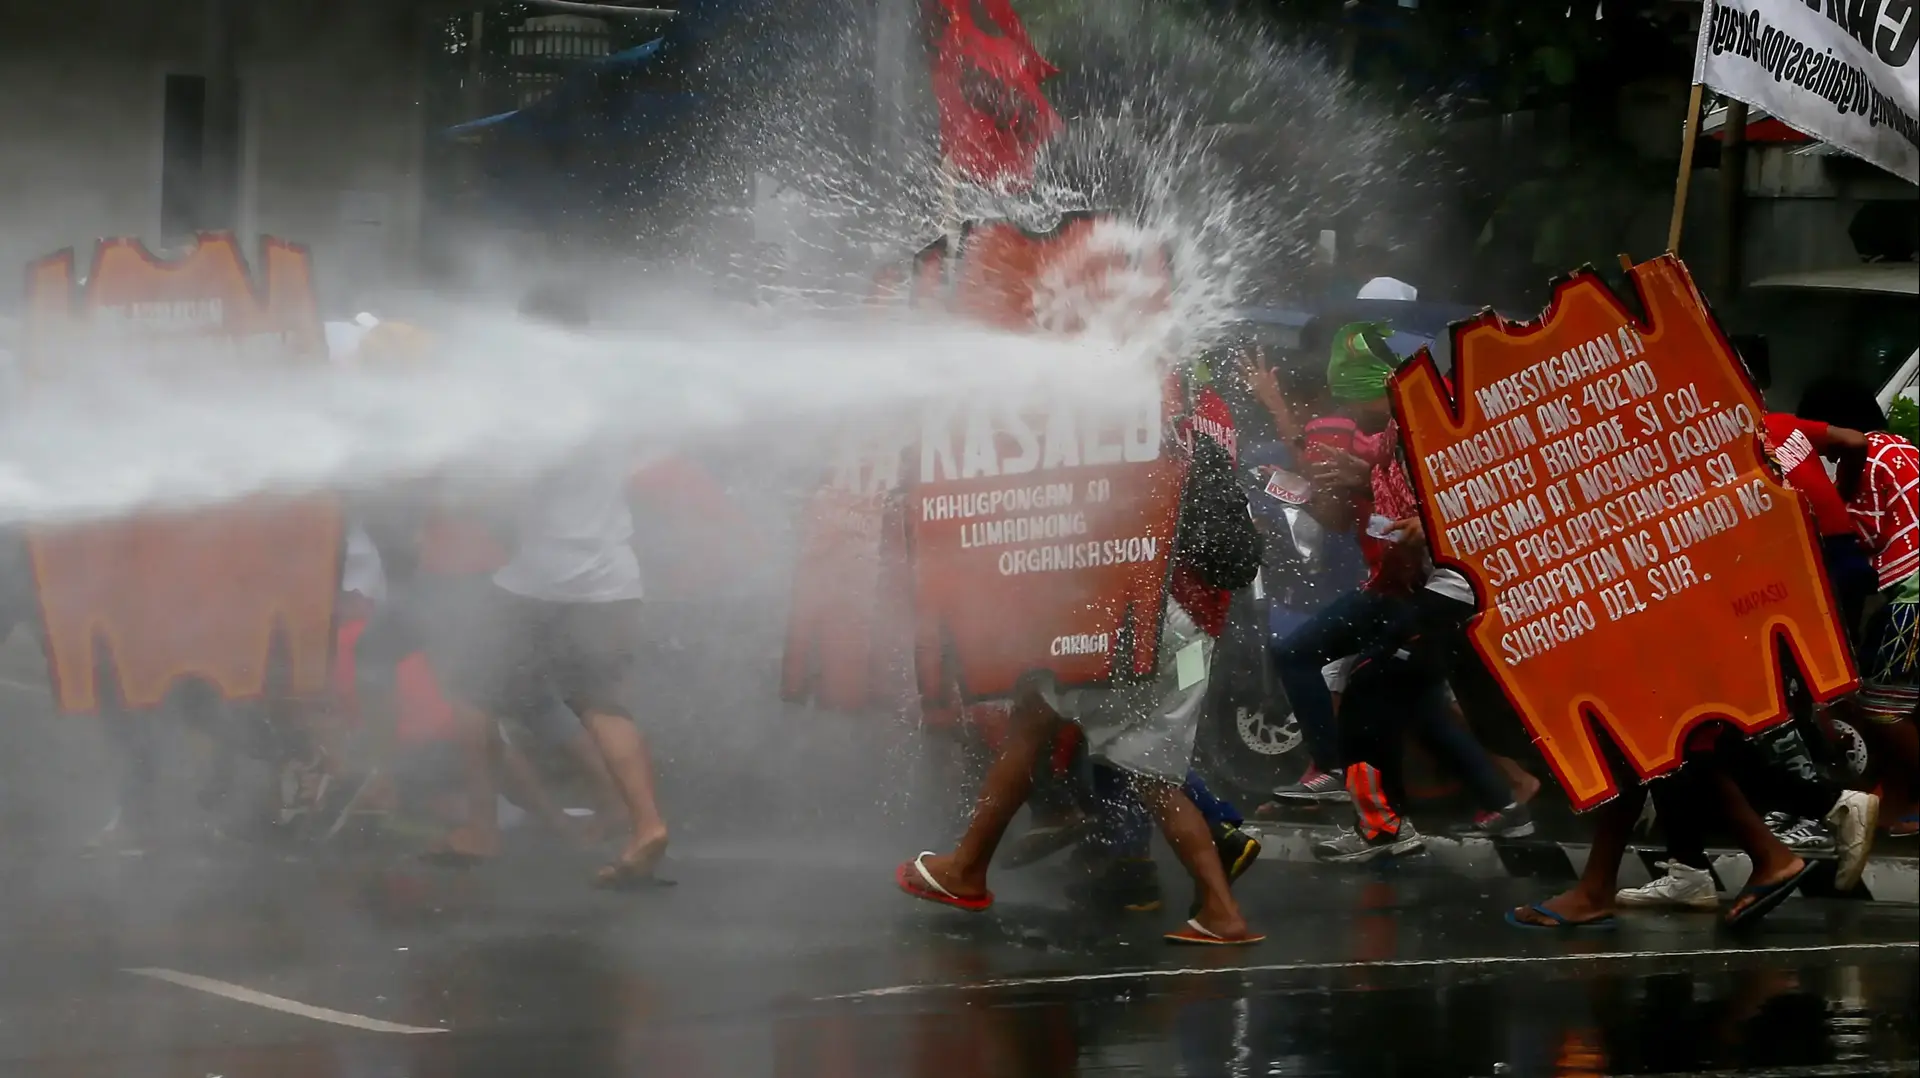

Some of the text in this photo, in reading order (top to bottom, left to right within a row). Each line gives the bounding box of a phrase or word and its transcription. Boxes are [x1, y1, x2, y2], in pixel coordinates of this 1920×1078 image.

[1475, 323, 1645, 420] IMBESTIGAHAN AT
[1425, 414, 1536, 486] PANAGUTIN
[1537, 394, 1581, 438] ANG
[1434, 383, 1719, 523] INFANTRY BRIGADE, SI COL.
[1446, 494, 1546, 560] PURISIMA
[1546, 478, 1575, 517] AT
[1576, 439, 1667, 503] NOYNOY
[1669, 404, 1754, 464] AQUINO
[922, 479, 1110, 521] KAHUGPONGAN SA
[961, 511, 1087, 548] LUMADNONG
[1483, 453, 1738, 586] SA PAGLAPASTANGAN SA
[999, 537, 1157, 576] ORGANISASYON
[1495, 479, 1772, 626] KARAPATAN NG LUMAD NG
[1050, 632, 1109, 656] CARAGA
[1502, 601, 1595, 665] SURIGAO
[1599, 579, 1646, 621] DEL
